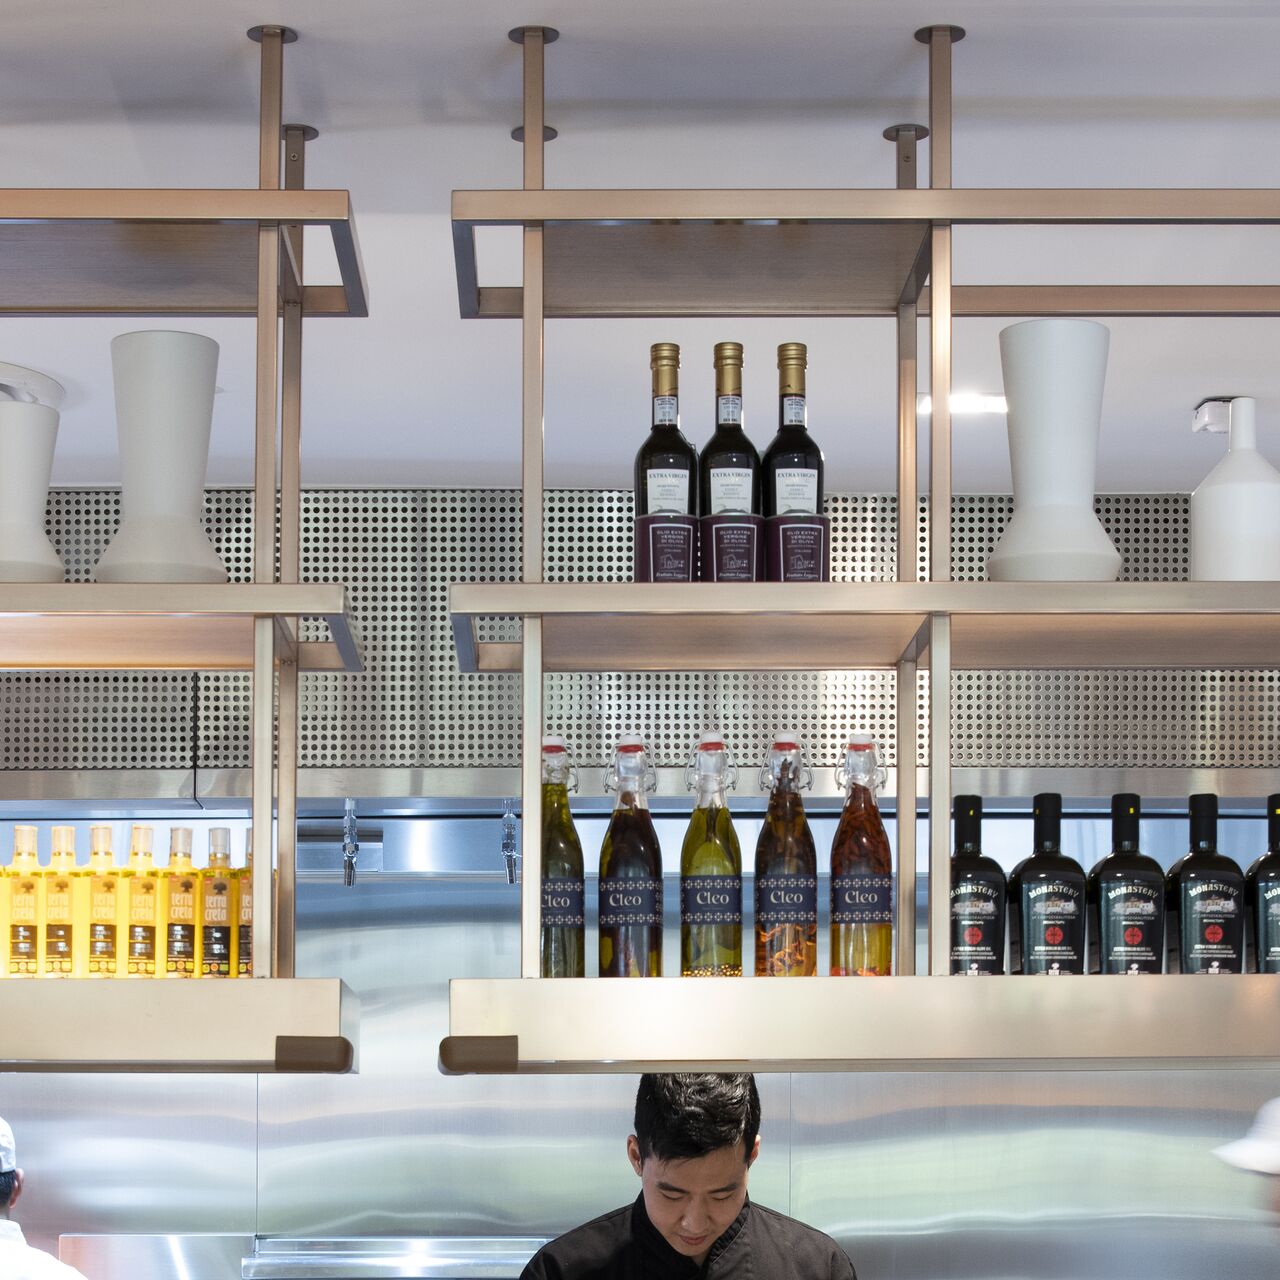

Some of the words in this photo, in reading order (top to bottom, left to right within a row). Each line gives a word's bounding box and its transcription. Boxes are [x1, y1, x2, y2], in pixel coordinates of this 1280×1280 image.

[770, 890, 804, 904] Cleo
[844, 890, 878, 904] Cleo
[1028, 885, 1079, 899] MONASTERY
[1108, 885, 1158, 900] MONASTERY
[1188, 883, 1239, 897] MONASTERY
[205, 895, 227, 908] terra
[609, 893, 642, 907] Cleo
[696, 891, 730, 905] Cleo
[205, 908, 227, 921] creta
